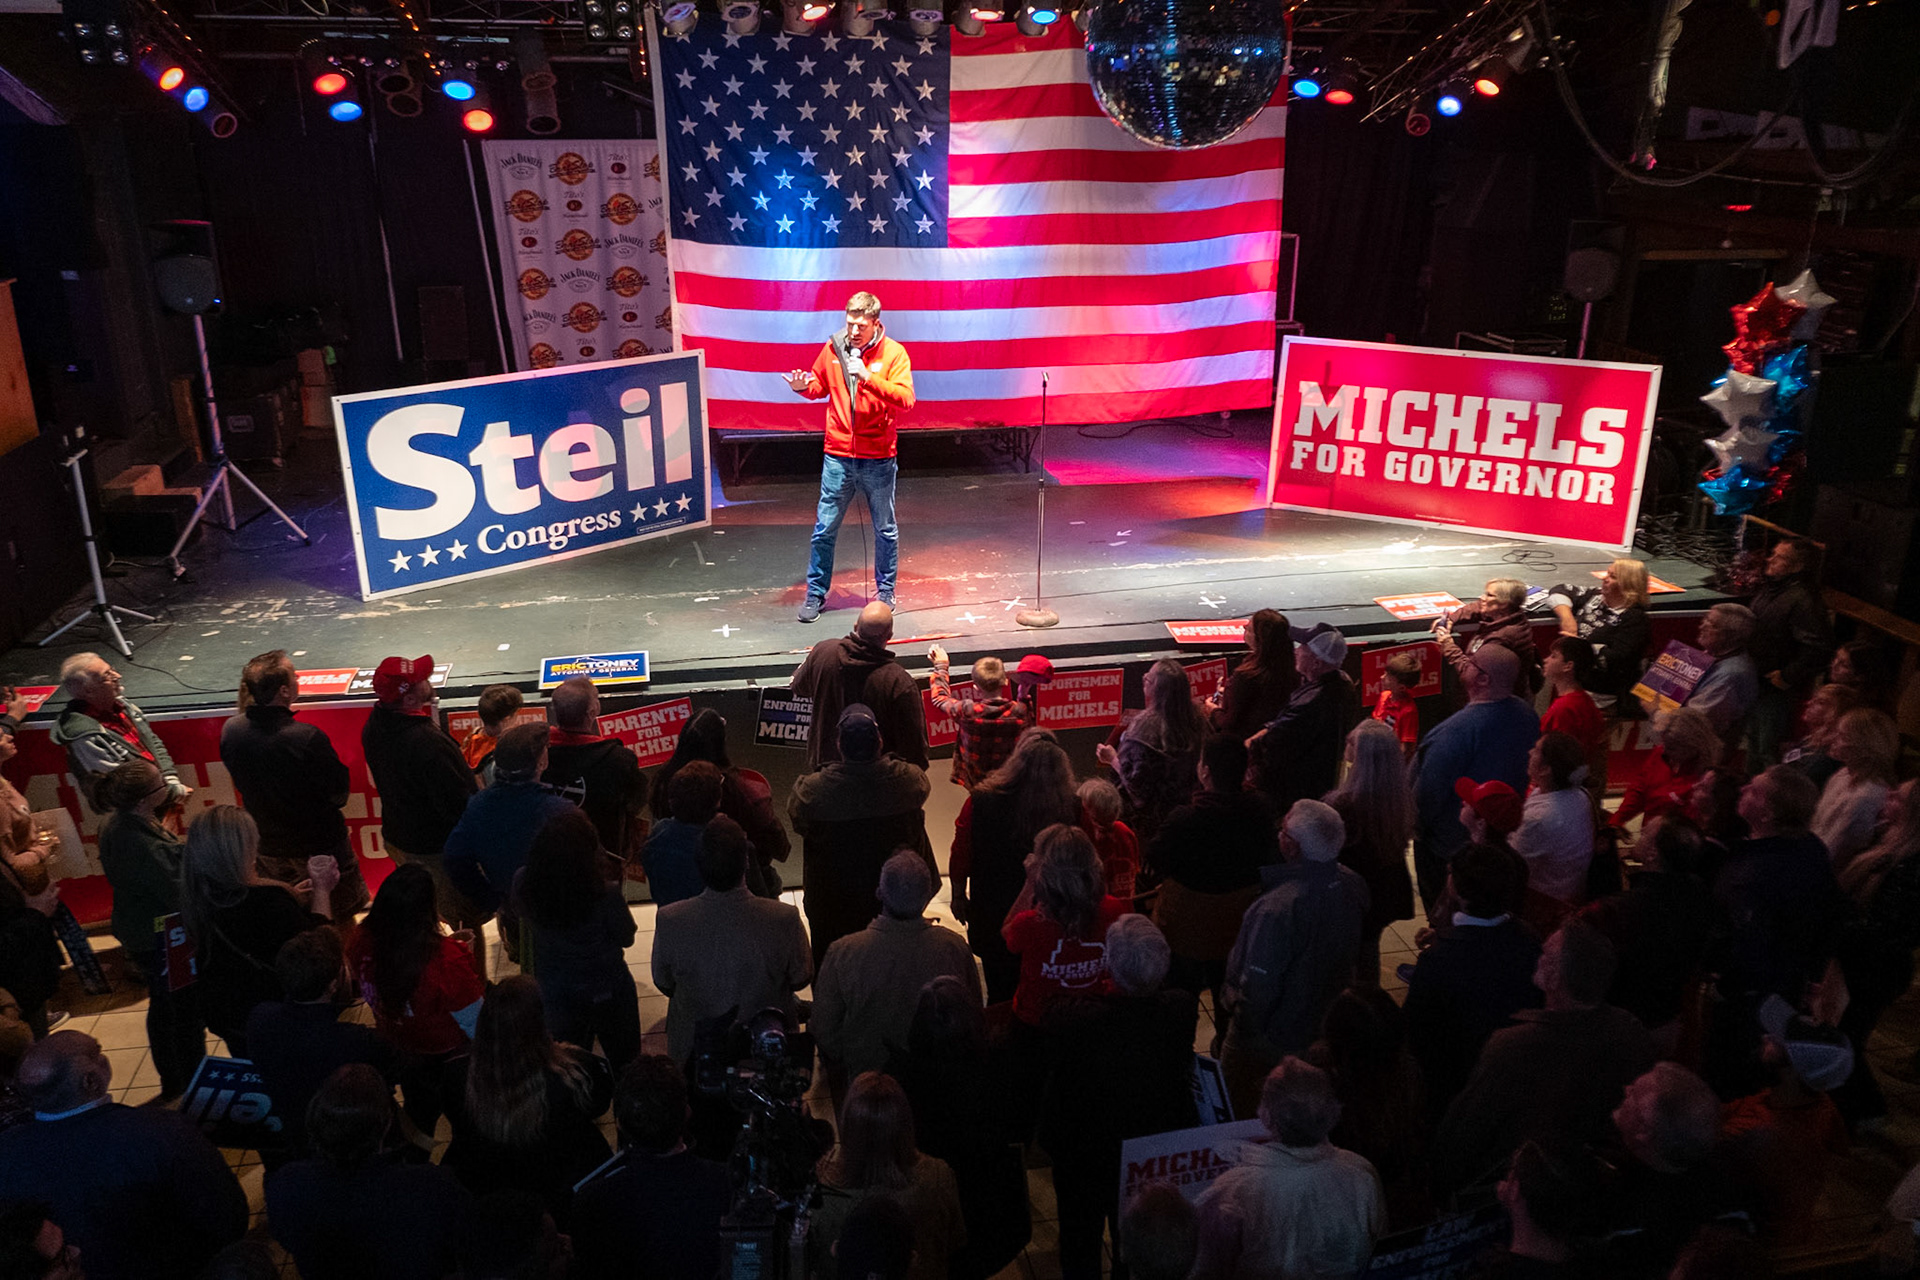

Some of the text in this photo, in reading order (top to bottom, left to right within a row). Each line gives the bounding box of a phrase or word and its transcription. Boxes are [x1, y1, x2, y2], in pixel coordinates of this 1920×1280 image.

[1293, 380, 1629, 469] MICHELS
[367, 381, 693, 541] Steil
[1290, 440, 1616, 506] FOR GOVERNOR
[477, 509, 622, 551] Congress
[550, 665, 638, 677] ATTORNEY GENERAL
[1039, 675, 1121, 691] SPORTSMEN
[1068, 690, 1091, 702] FOR
[763, 700, 814, 713] ENFORCE
[1039, 701, 1120, 721] MICHELS
[601, 703, 691, 736] PARENTS
[636, 726, 663, 741] FOR
[758, 721, 810, 741] MICH
[1126, 1147, 1230, 1184] MICH
